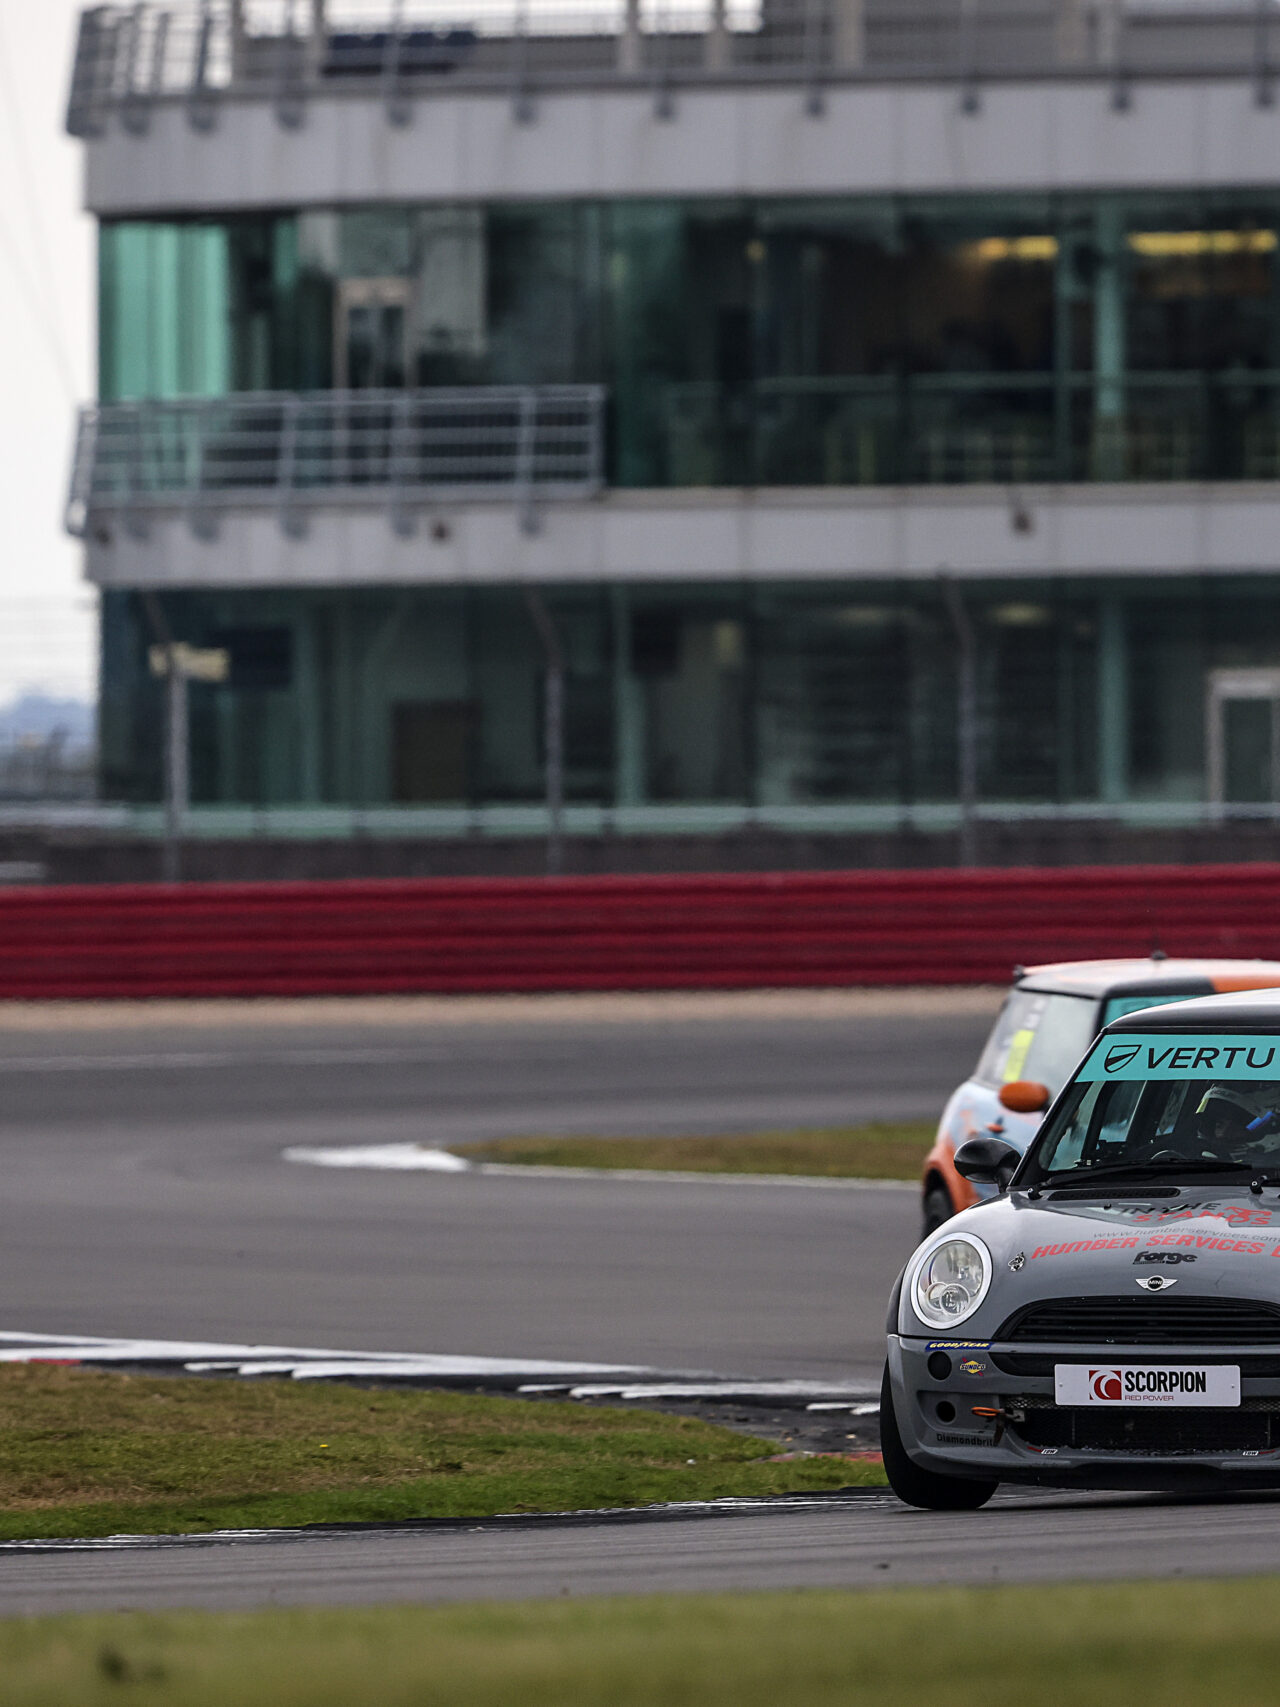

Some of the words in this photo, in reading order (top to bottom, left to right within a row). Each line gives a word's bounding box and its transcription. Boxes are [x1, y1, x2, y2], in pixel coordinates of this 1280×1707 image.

[1146, 1047, 1276, 1069] VERTU
[1031, 1236, 1140, 1260] HUMBER
[1146, 1234, 1267, 1254] SERVICES
[929, 1341, 990, 1349] GOODYEAR
[960, 1363, 986, 1371] SUNOCO
[1124, 1370, 1207, 1393] SCORPION
[936, 1432, 998, 1448] Diamondbrit
